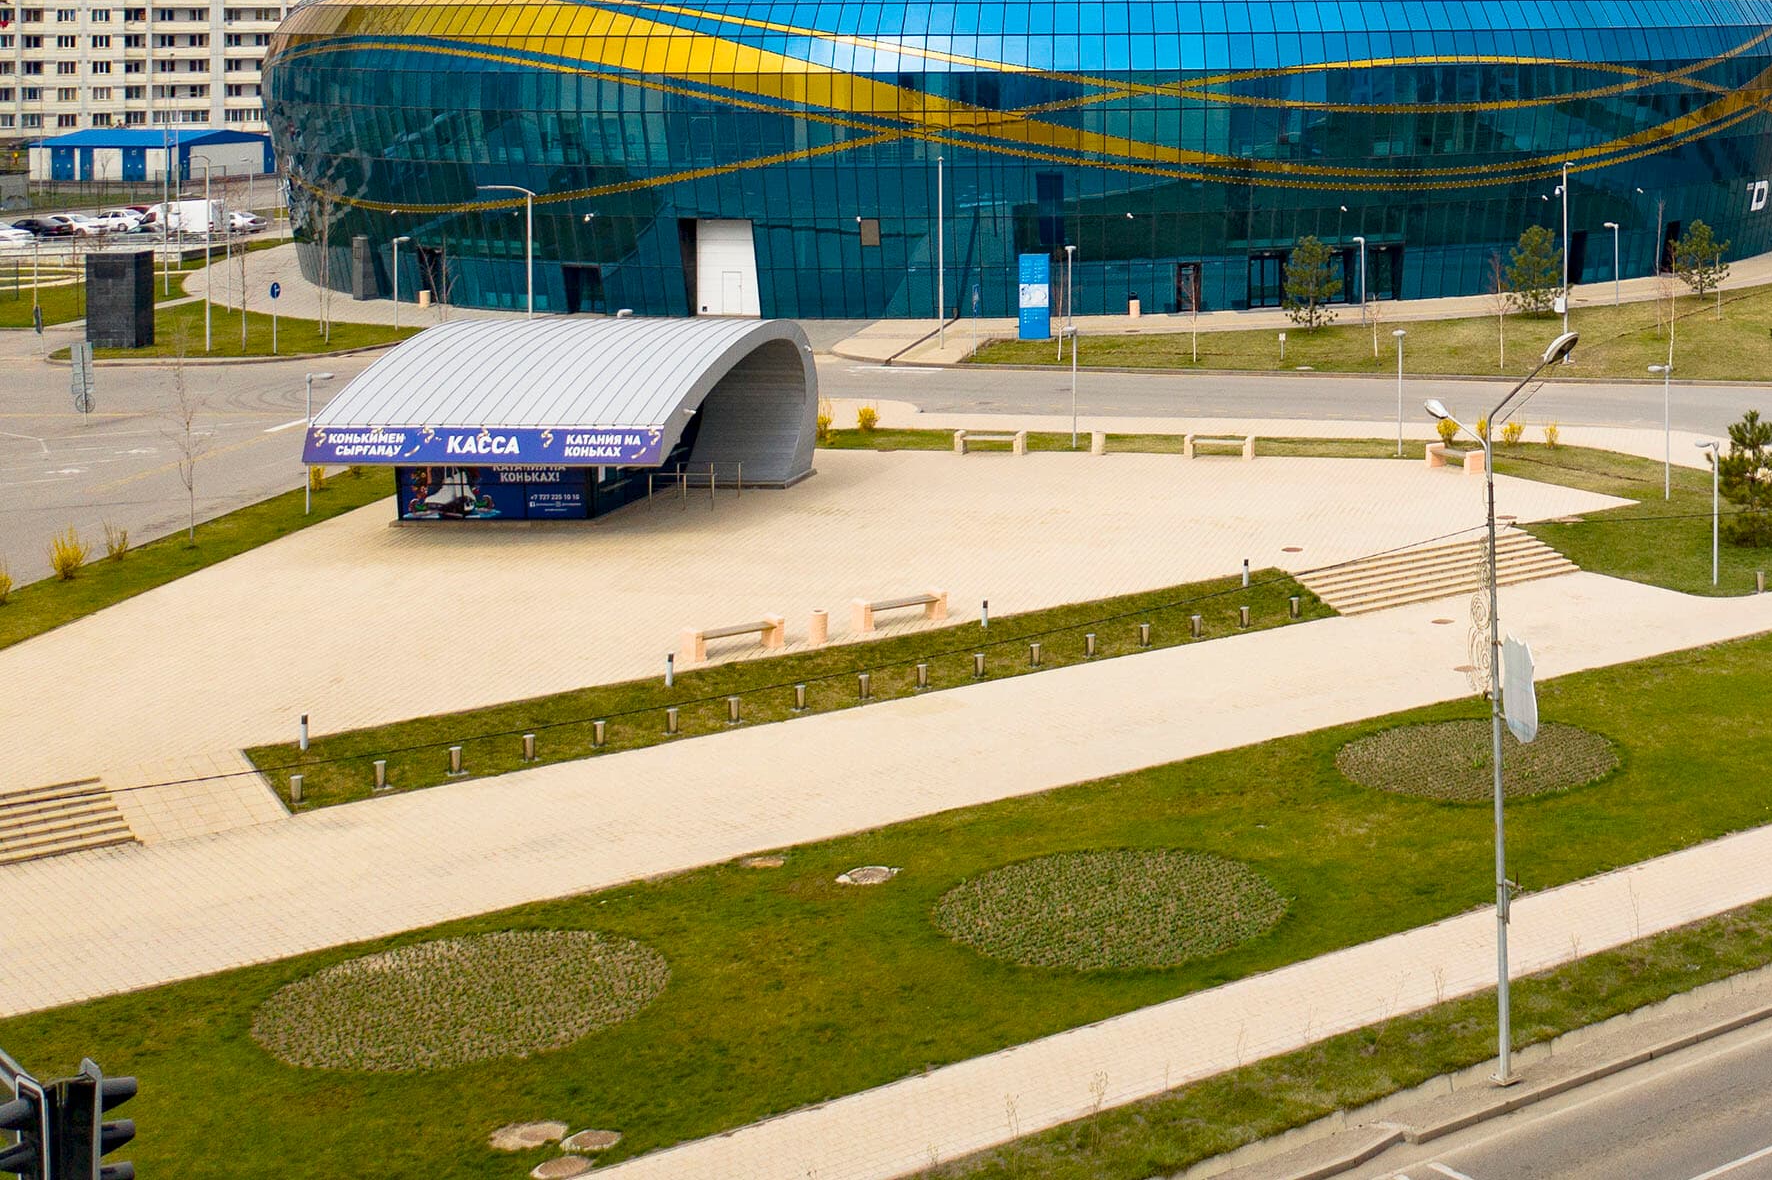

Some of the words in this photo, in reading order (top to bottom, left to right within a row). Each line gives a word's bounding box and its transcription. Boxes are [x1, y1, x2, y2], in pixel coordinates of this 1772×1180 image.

[1750, 180, 1769, 211] D
[446, 435, 520, 455] КАССА
[566, 434, 622, 446] КАТАНИЯ
[623, 434, 642, 446] НА
[564, 446, 622, 458] КОНЬКАХ
[500, 472, 561, 483] КОНЬКАХ!
